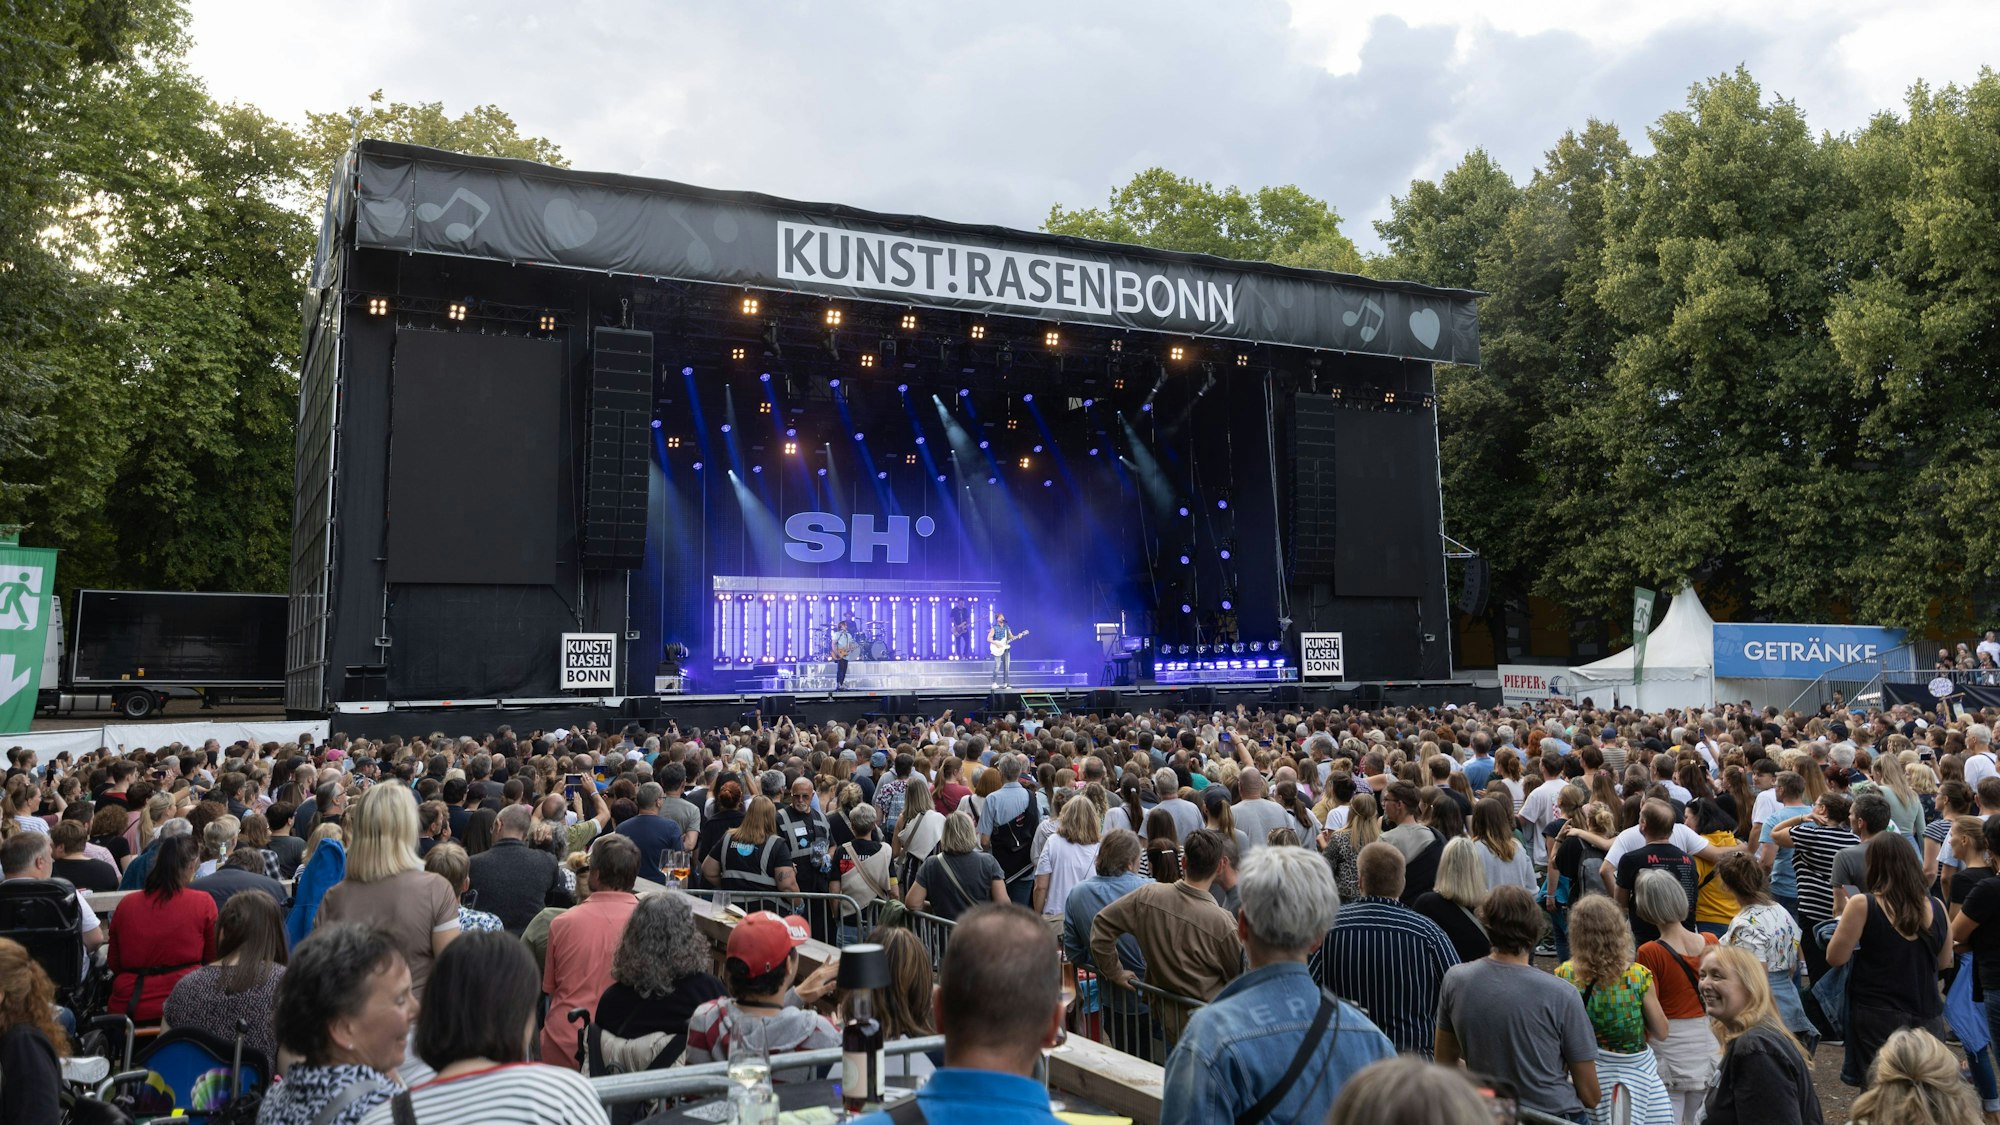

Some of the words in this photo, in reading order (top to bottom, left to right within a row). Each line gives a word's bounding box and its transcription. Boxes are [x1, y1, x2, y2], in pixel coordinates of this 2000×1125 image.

[1115, 270, 1234, 324] BONN
[567, 640, 611, 653] KUNST!
[1305, 638, 1339, 648] KUNST!
[1307, 649, 1338, 659] RASEN
[1743, 637, 1877, 663] GETRÄNKE
[569, 654, 609, 667] RASEN
[1306, 661, 1340, 671] BONN
[567, 670, 610, 682] BONN
